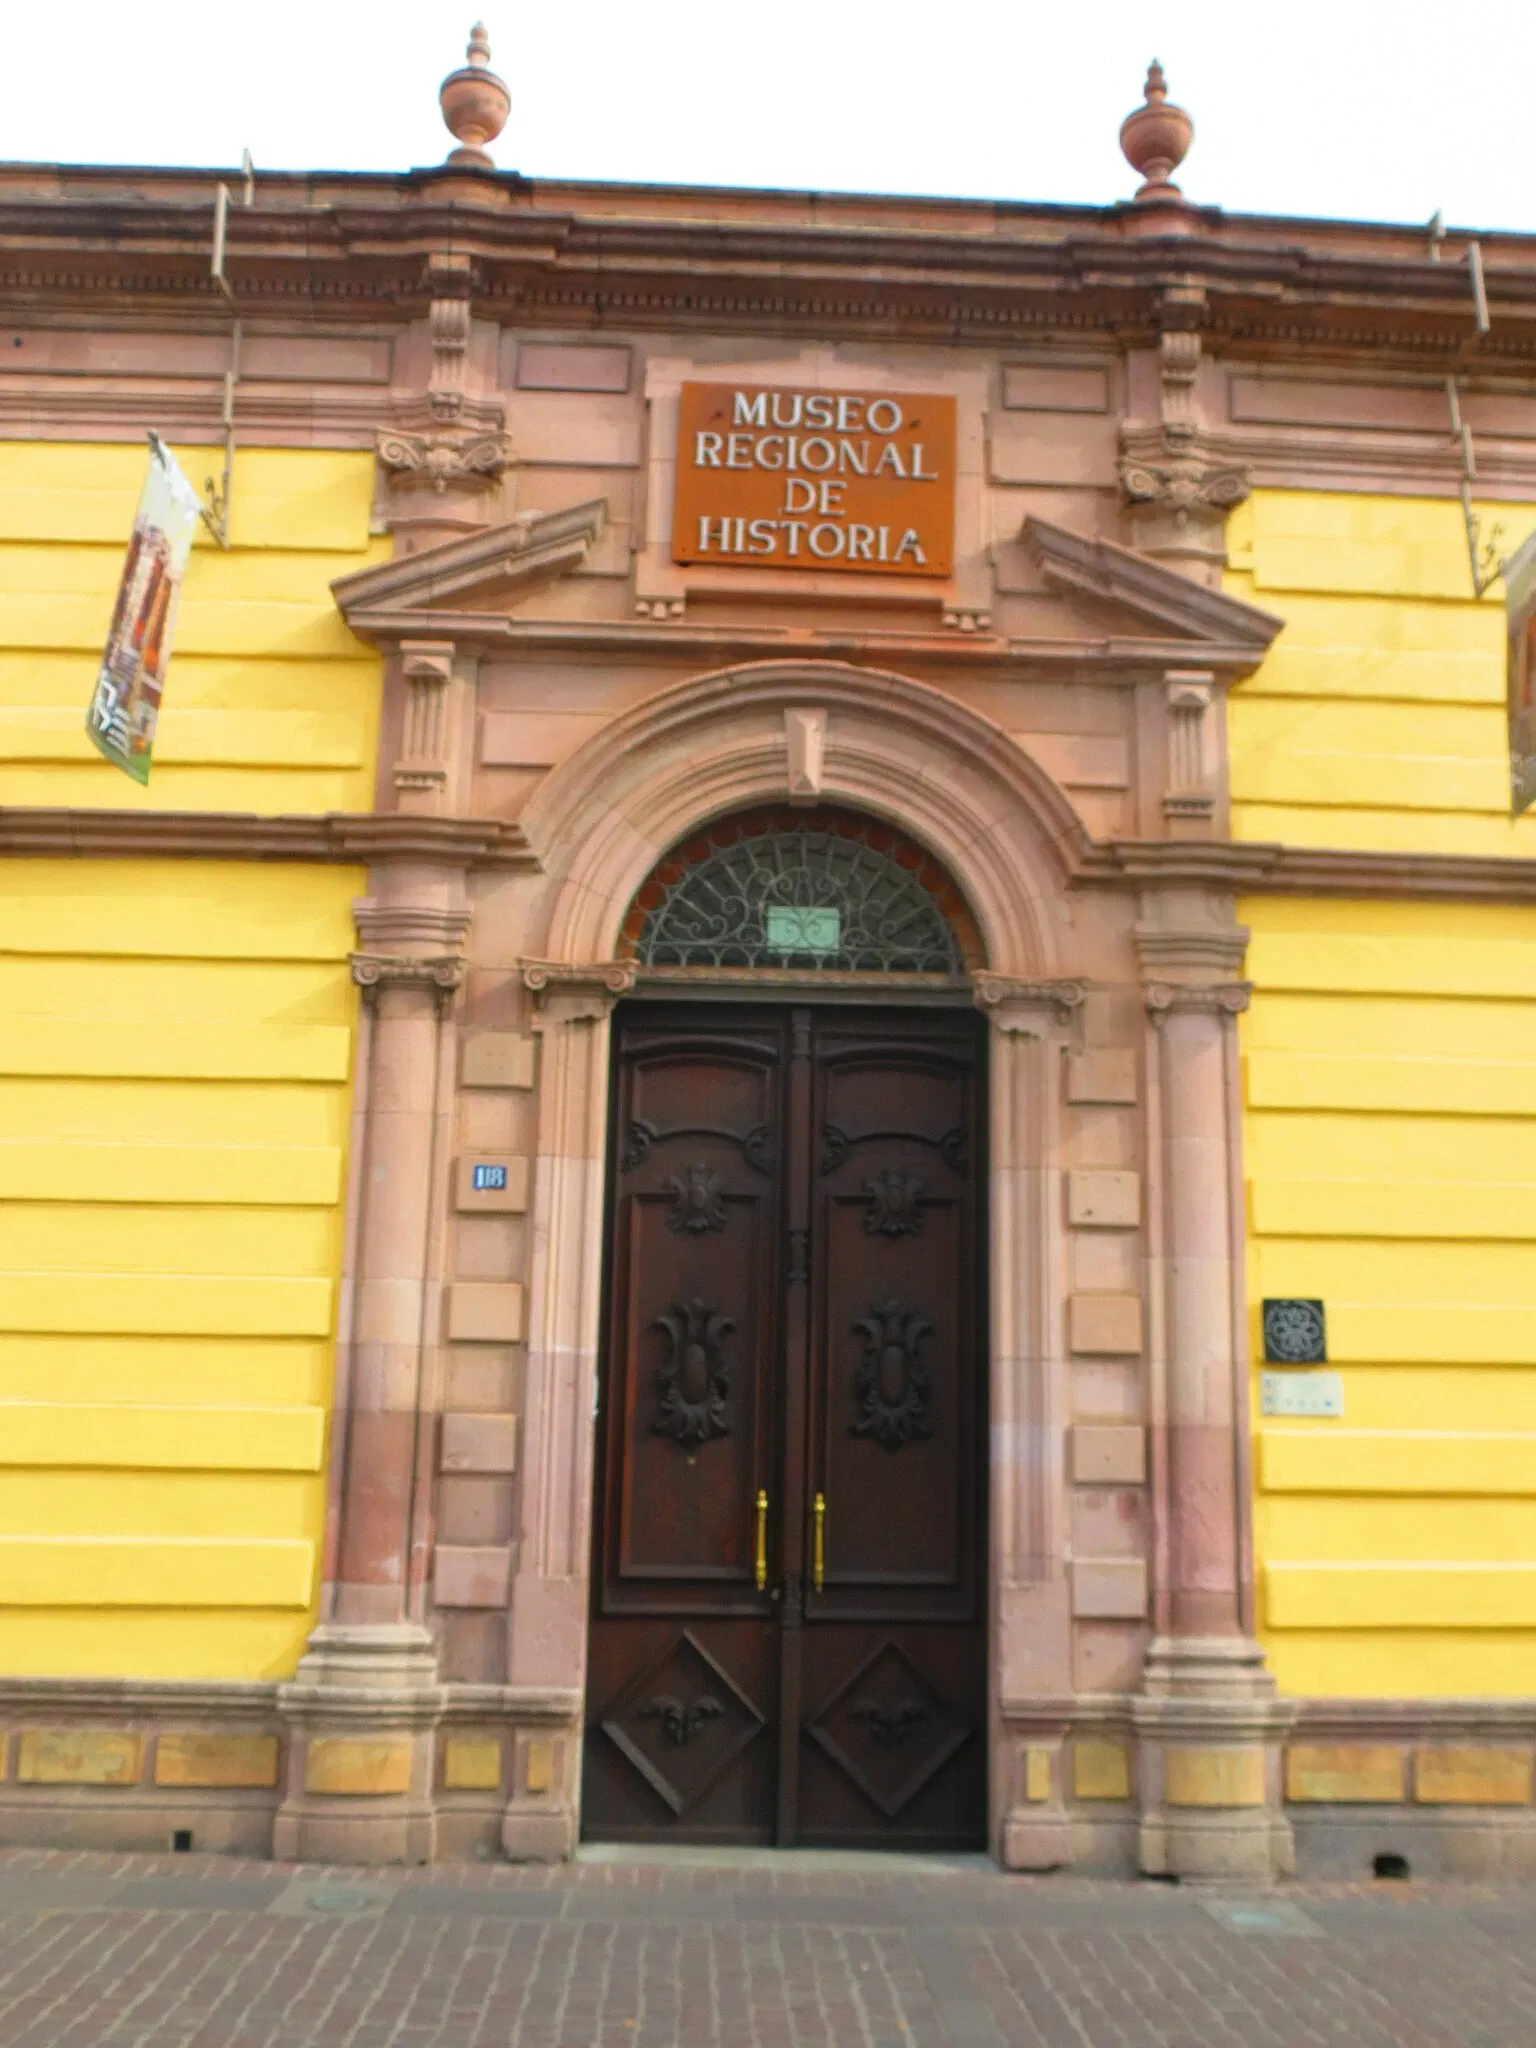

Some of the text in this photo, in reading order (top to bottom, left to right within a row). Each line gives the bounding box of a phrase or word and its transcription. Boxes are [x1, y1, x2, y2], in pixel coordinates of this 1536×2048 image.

[732, 391, 903, 435] MUSEO
[695, 431, 938, 481] REGIONAL
[784, 477, 848, 516] DE
[698, 515, 927, 565] HISTORIA
